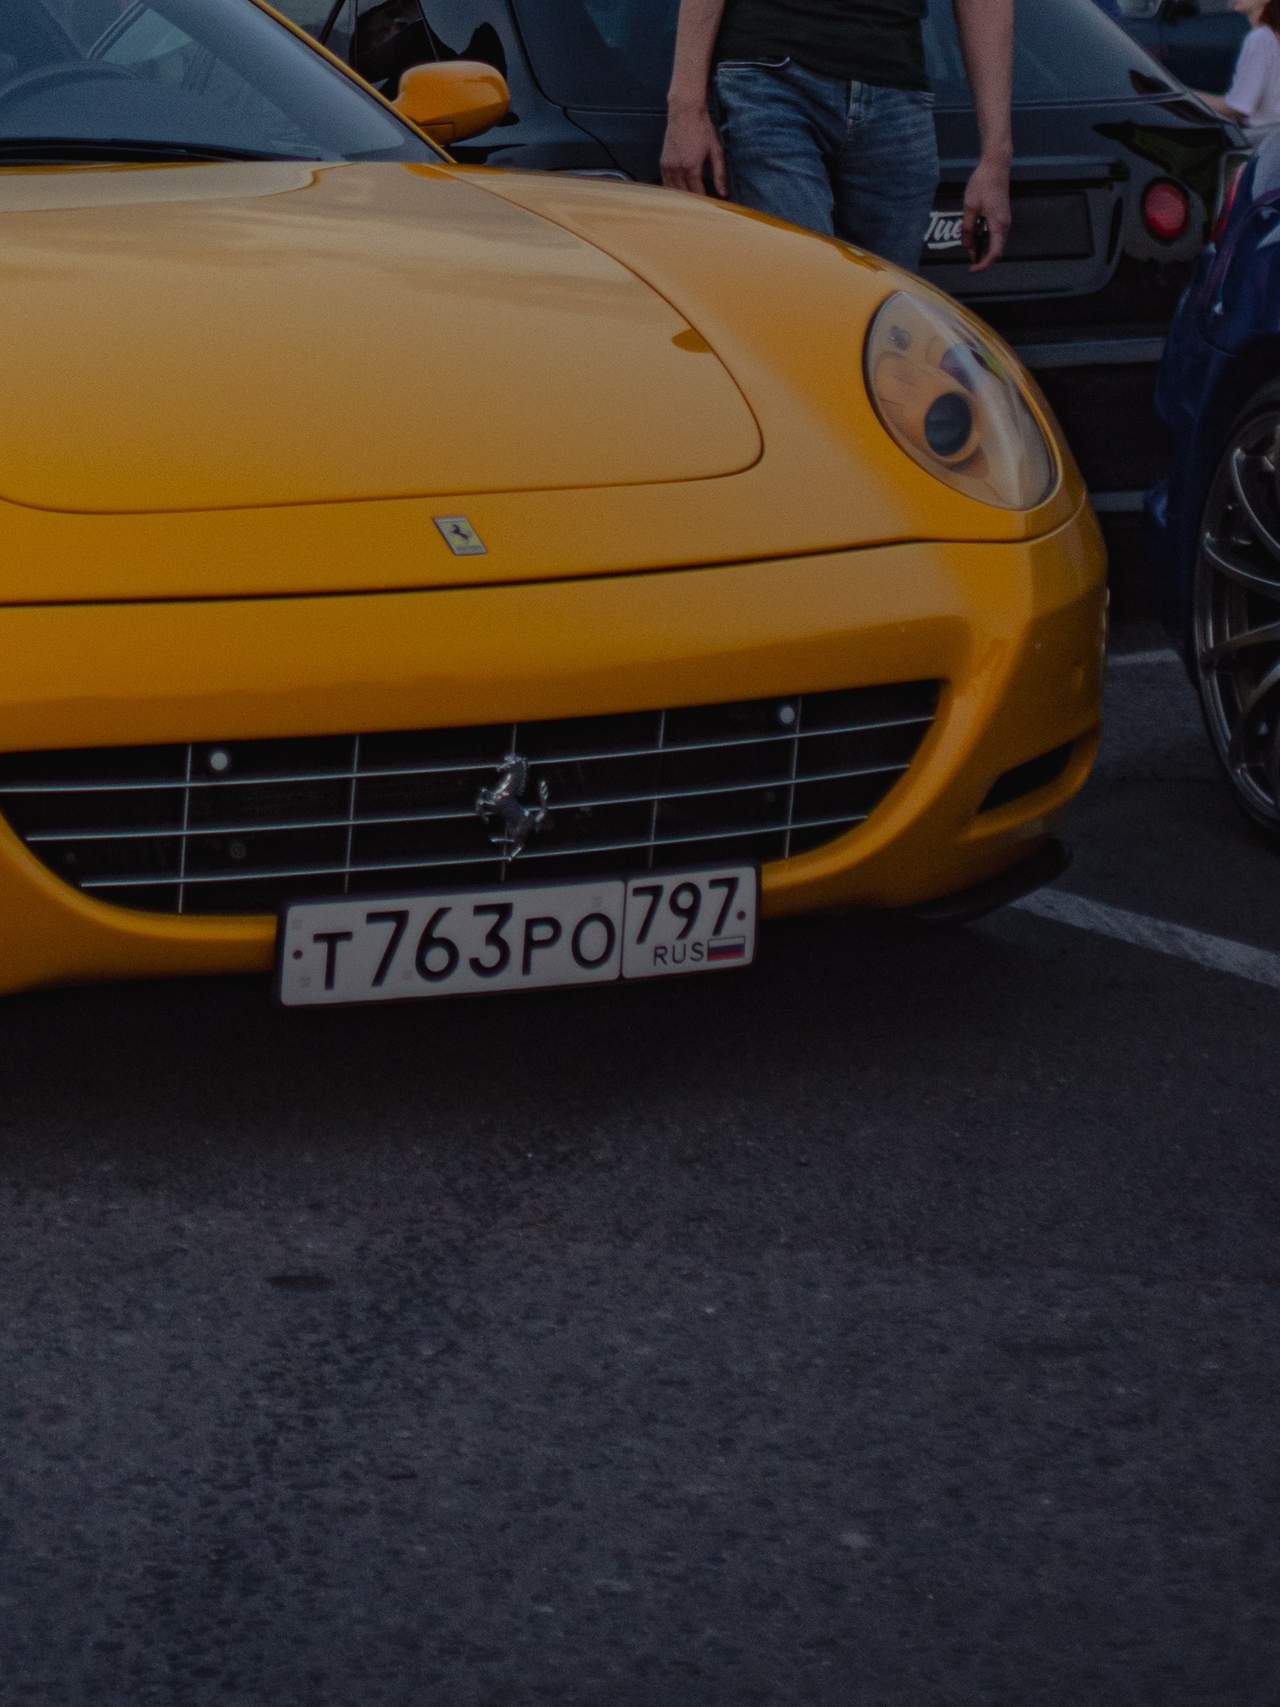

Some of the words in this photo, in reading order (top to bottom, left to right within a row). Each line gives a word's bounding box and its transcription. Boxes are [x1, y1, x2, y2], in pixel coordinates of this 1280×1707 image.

[312, 902, 617, 991] Т763РО
[632, 877, 739, 945] 797
[653, 942, 704, 966] RUS
